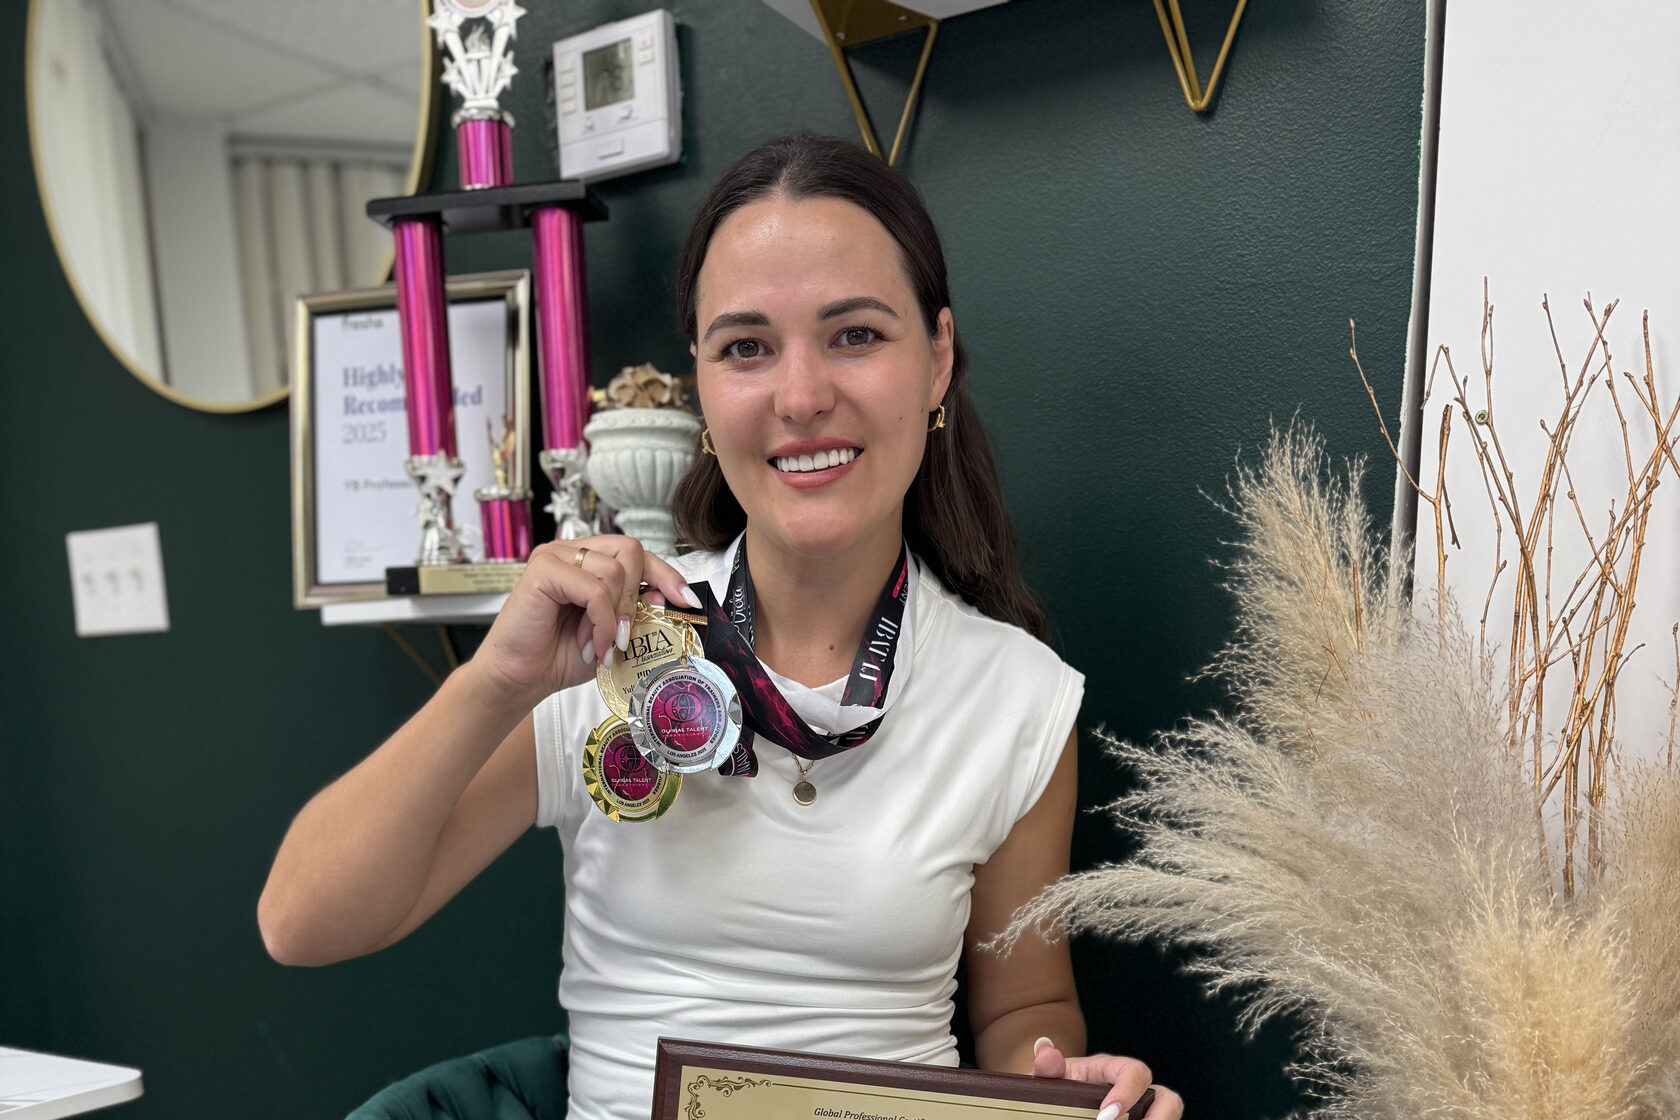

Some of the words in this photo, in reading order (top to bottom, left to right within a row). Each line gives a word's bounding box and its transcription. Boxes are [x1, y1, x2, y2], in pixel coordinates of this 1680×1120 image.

[662, 675, 696, 686] ASSOCIATION
[649, 686, 662, 704] BEAUTY
[646, 705, 661, 746] INTERNATIONAL
[734, 742, 751, 774] NAILS
[814, 1107, 842, 1118] Global
